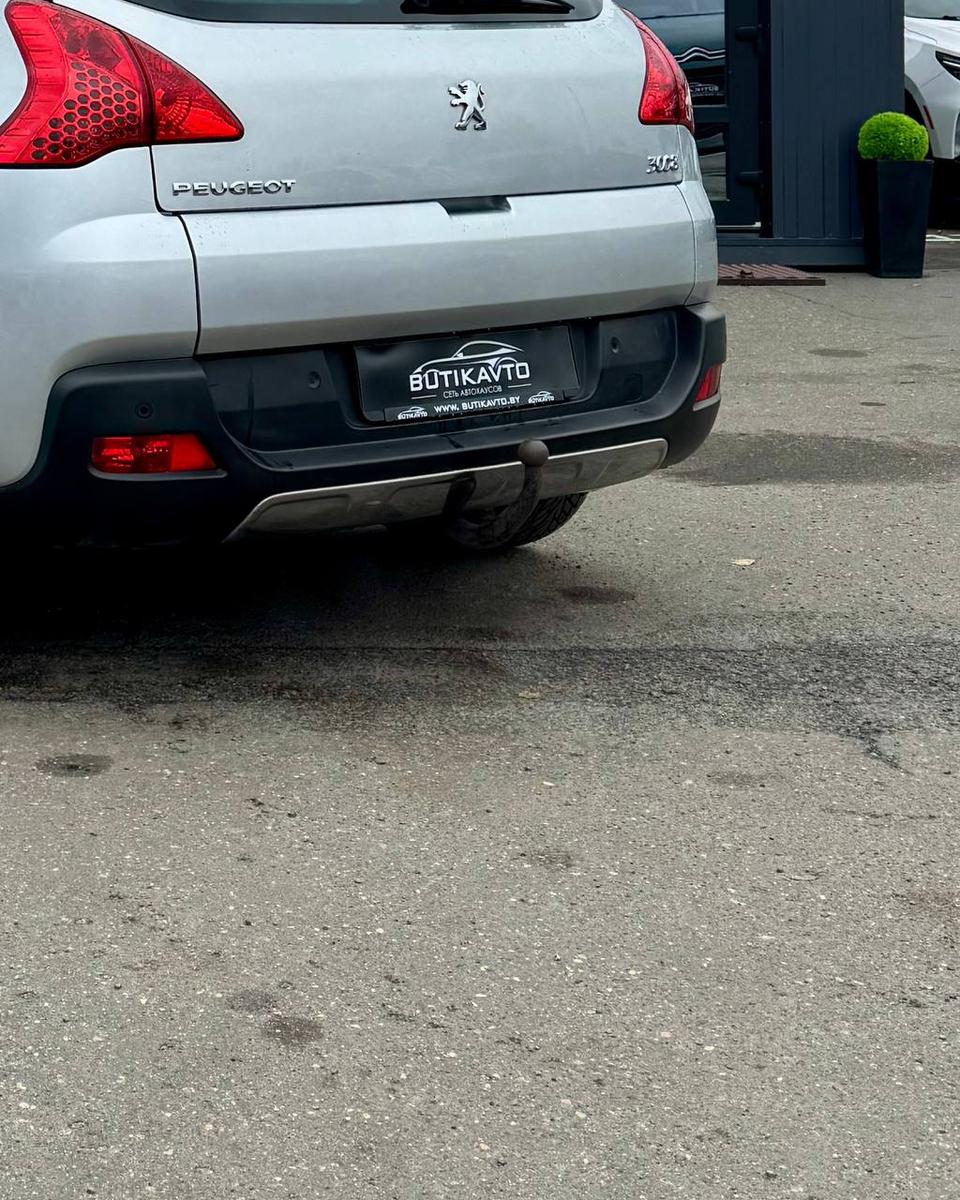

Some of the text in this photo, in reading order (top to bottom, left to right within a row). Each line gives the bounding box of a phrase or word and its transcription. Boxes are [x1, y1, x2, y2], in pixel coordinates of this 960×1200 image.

[646, 154, 679, 174] 3008
[172, 179, 297, 197] PEUGEOT
[409, 362, 531, 392] BUTIKAVTO
[443, 385, 503, 399] СЕТЬ АВТОХАУСОВ
[433, 395, 521, 414] WWW. BUTIKAVTO.BY
